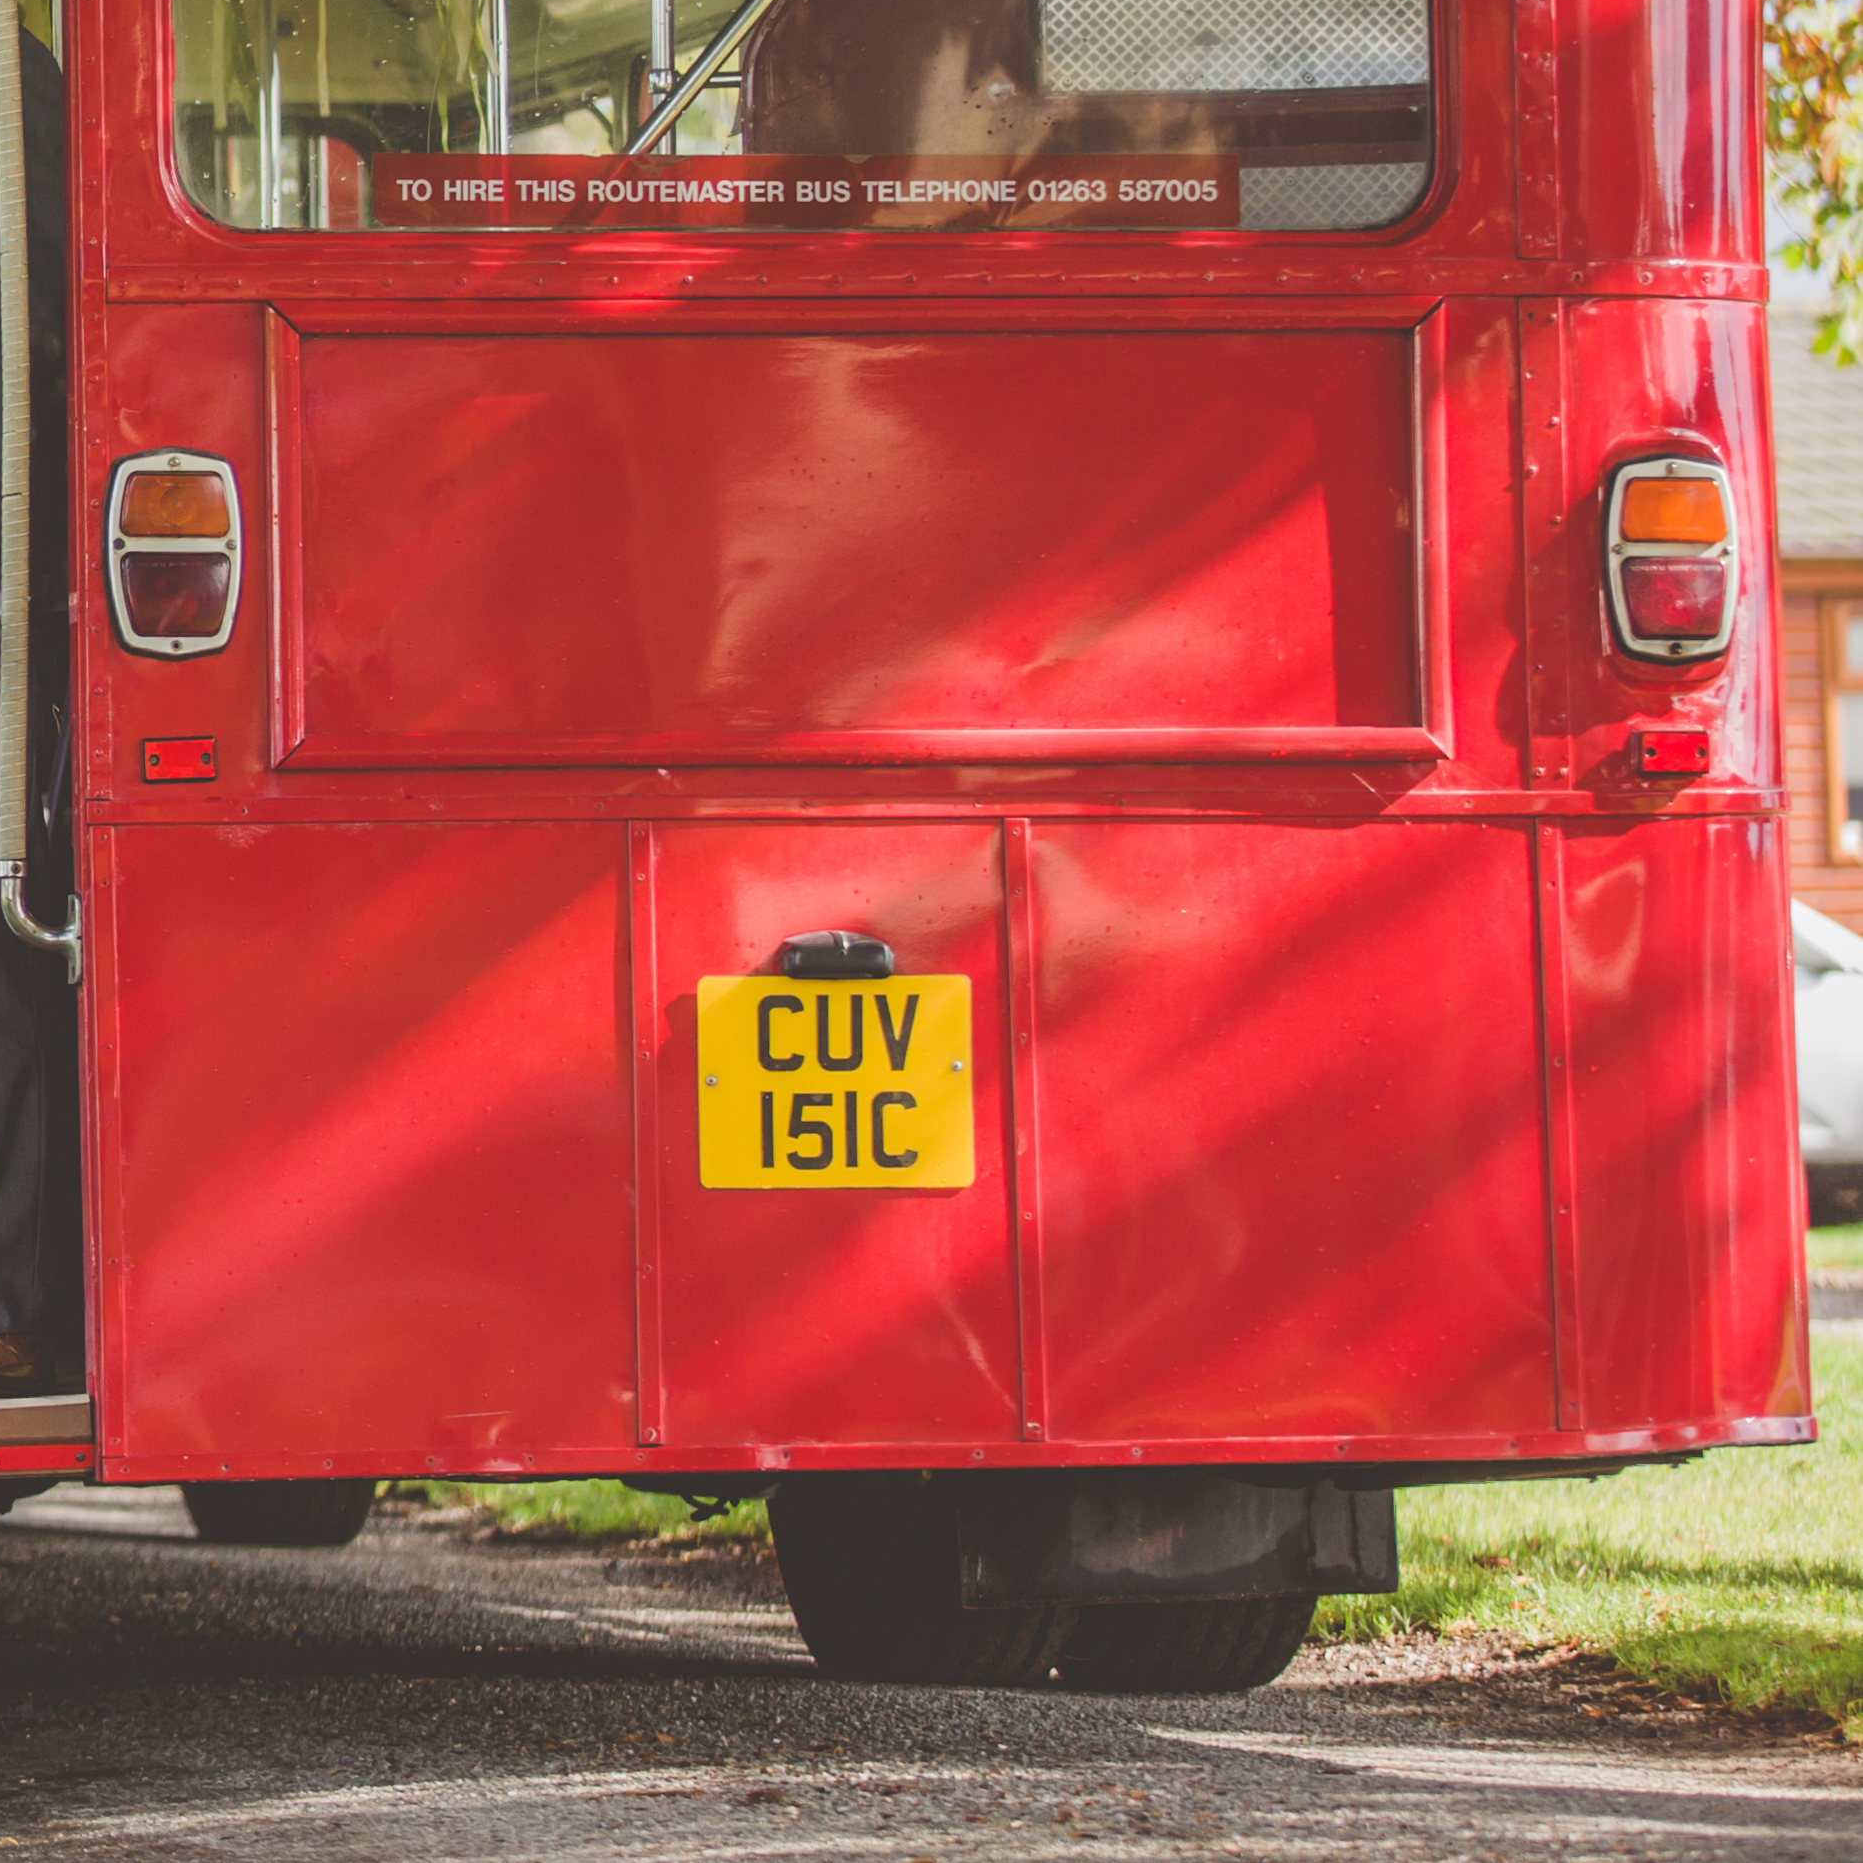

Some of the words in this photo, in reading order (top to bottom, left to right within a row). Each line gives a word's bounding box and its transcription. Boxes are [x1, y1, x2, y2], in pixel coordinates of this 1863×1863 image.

[396, 178, 432, 203] TO
[444, 178, 505, 203] HIRE
[515, 178, 576, 203] THIS
[587, 178, 785, 203] ROUTEMASTER
[796, 178, 851, 203] BUS
[861, 178, 1017, 203] TELEPHONE
[1027, 178, 1107, 203] 01263
[1118, 178, 1218, 203] 587005
[757, 994, 920, 1072] CUV
[760, 1091, 919, 1170] 151C
